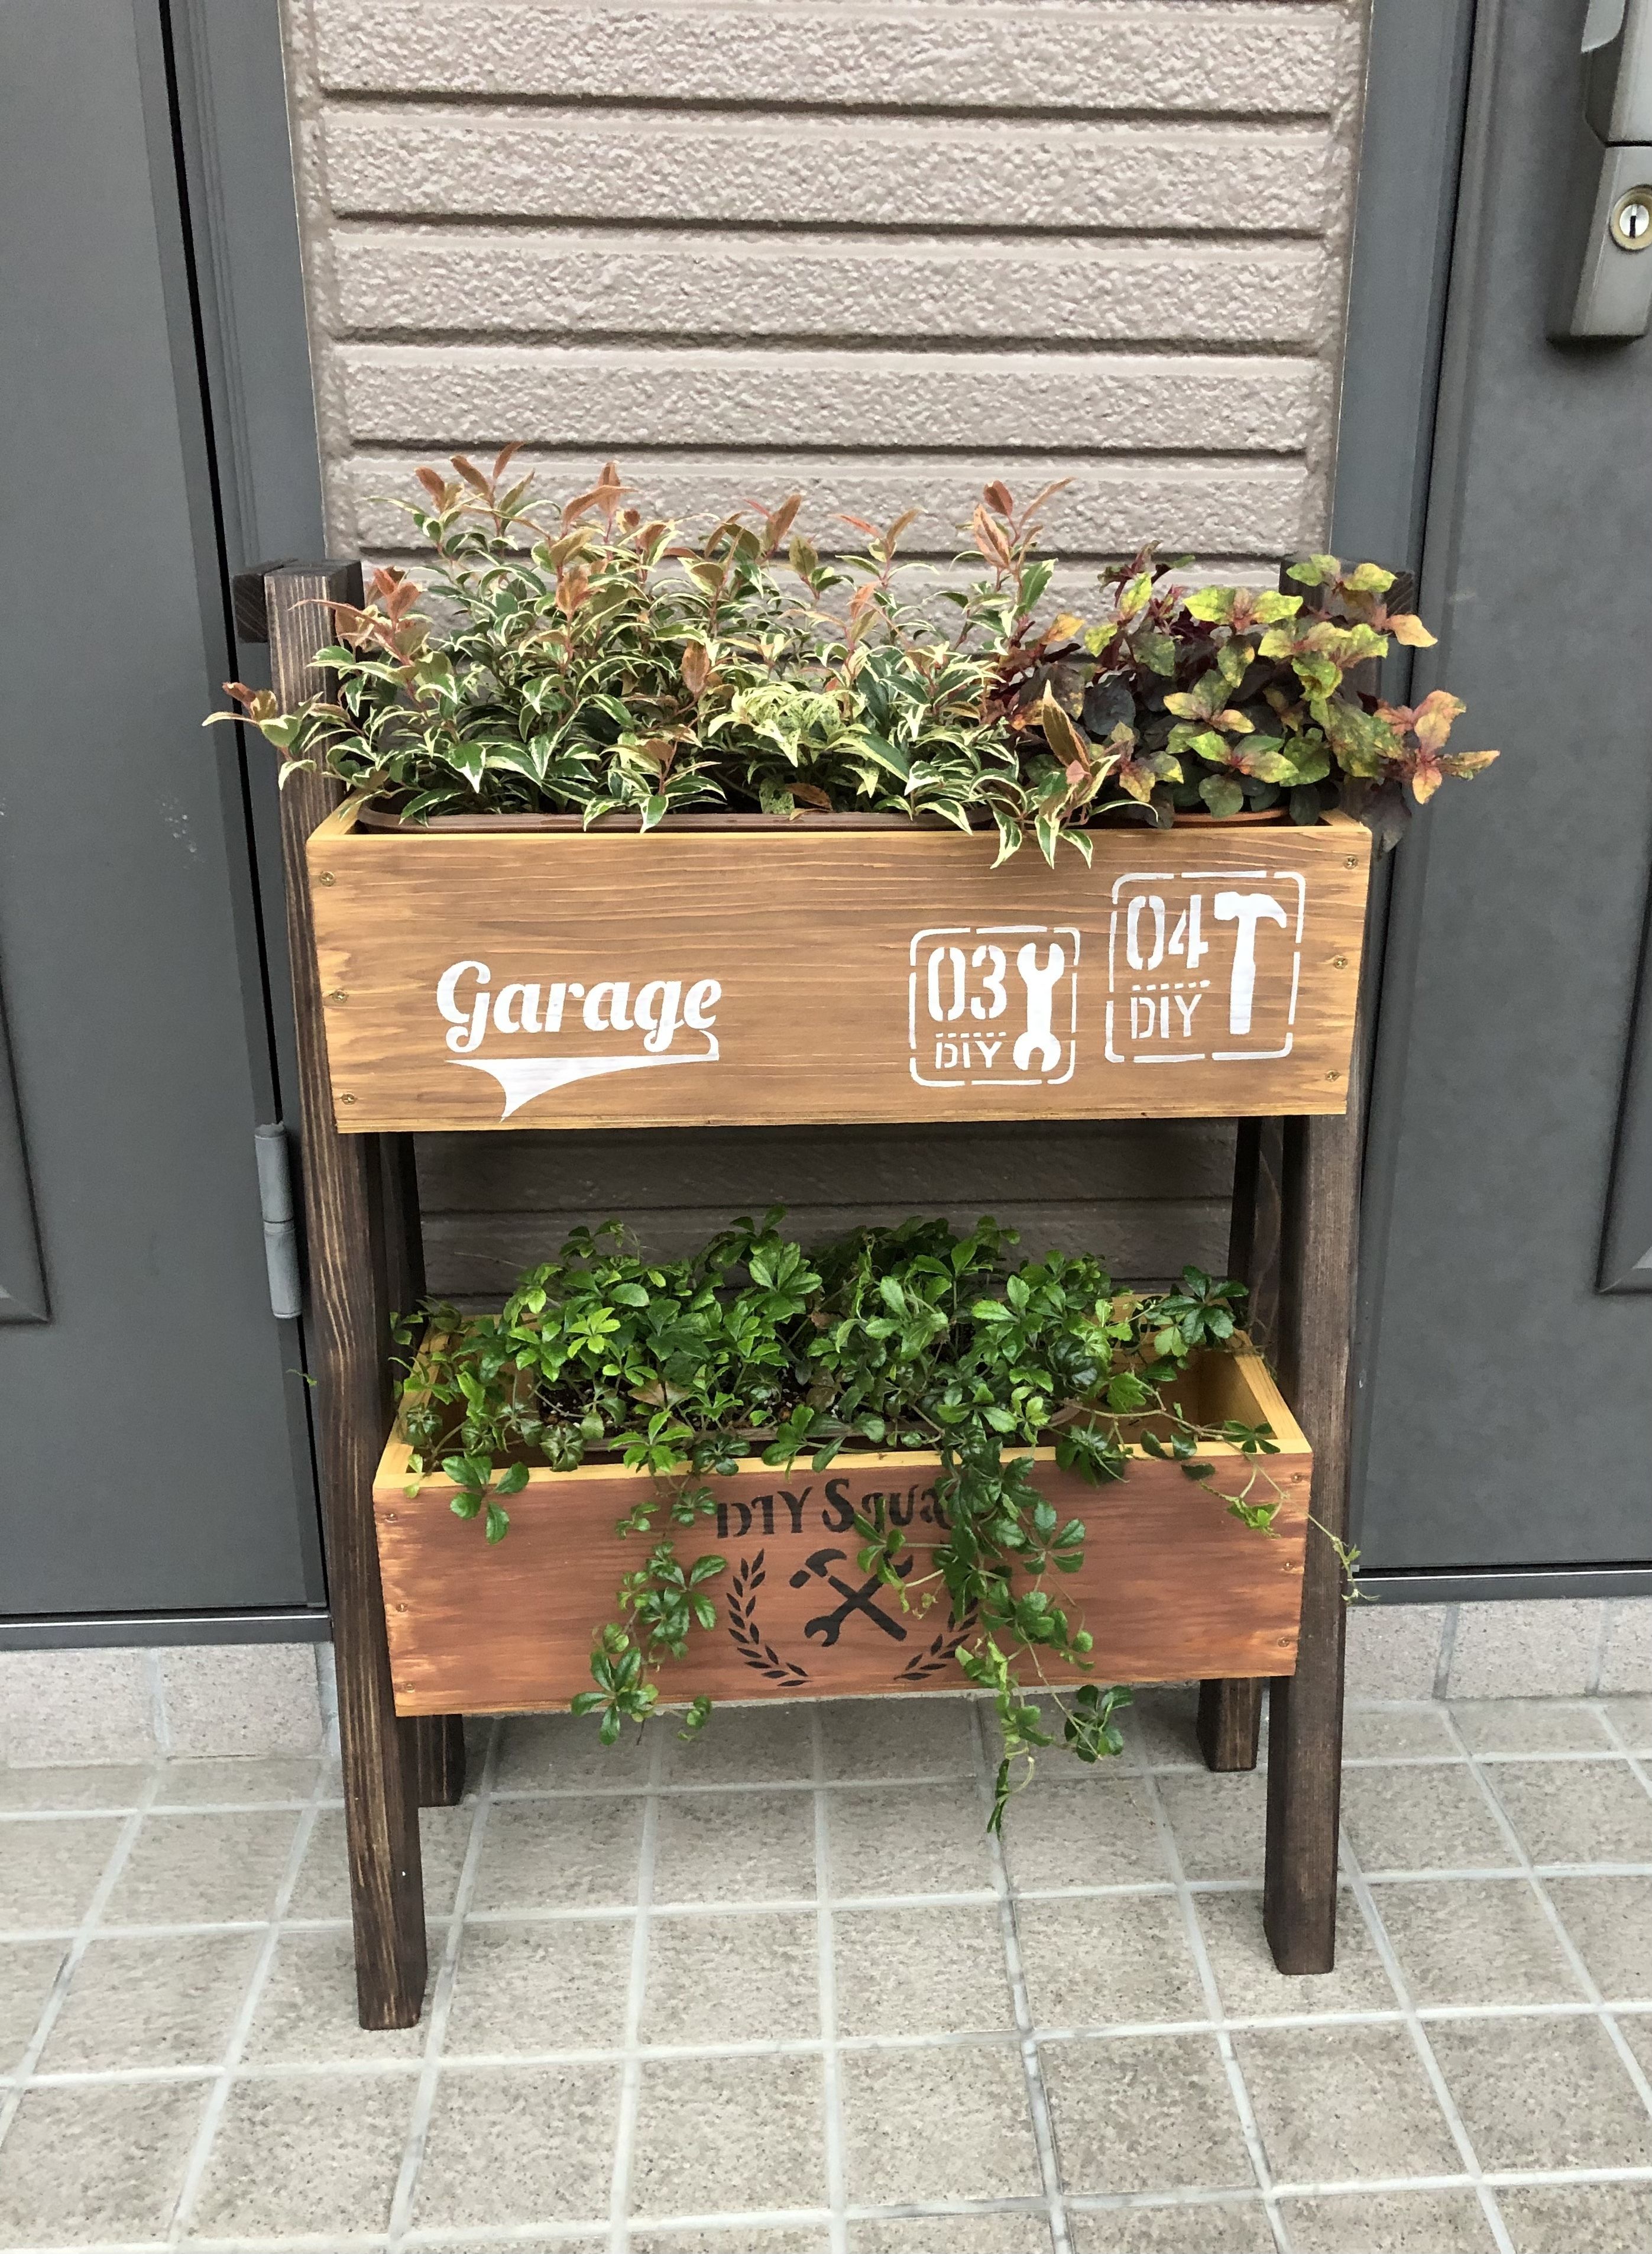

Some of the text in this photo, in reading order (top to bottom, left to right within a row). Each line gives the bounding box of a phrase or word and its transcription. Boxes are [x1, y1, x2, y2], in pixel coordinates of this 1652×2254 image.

[1126, 894, 1209, 970] 04
[436, 961, 722, 1053] Garage
[928, 945, 1007, 1021] 03
[1131, 994, 1201, 1039] DIY
[935, 1040, 1002, 1069] DIY
[717, 1485, 813, 1538] DIY
